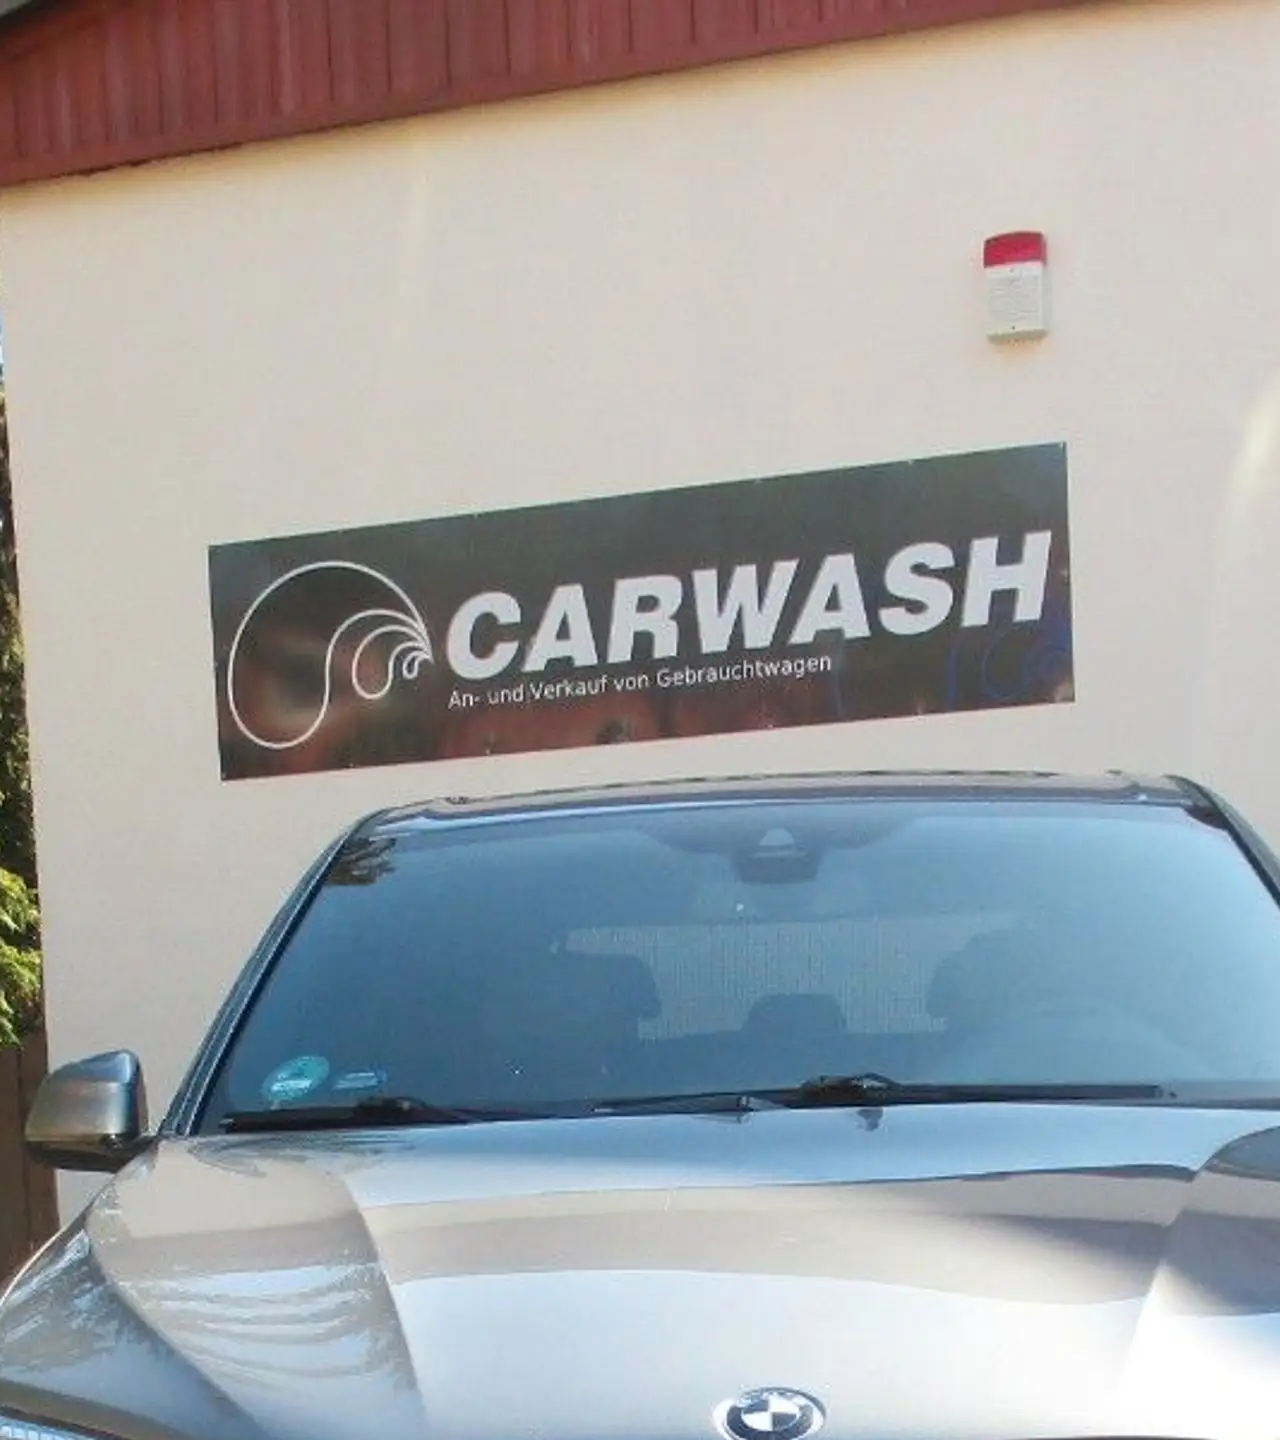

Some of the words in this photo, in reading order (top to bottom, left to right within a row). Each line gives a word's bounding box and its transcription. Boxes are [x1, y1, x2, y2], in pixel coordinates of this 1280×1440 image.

[446, 531, 1052, 680] CARWASH
[448, 690, 481, 709] An-
[486, 683, 524, 705] und
[529, 674, 608, 699] Verkauf
[613, 672, 649, 691] von
[656, 655, 832, 688] Gebrauchtwagen
